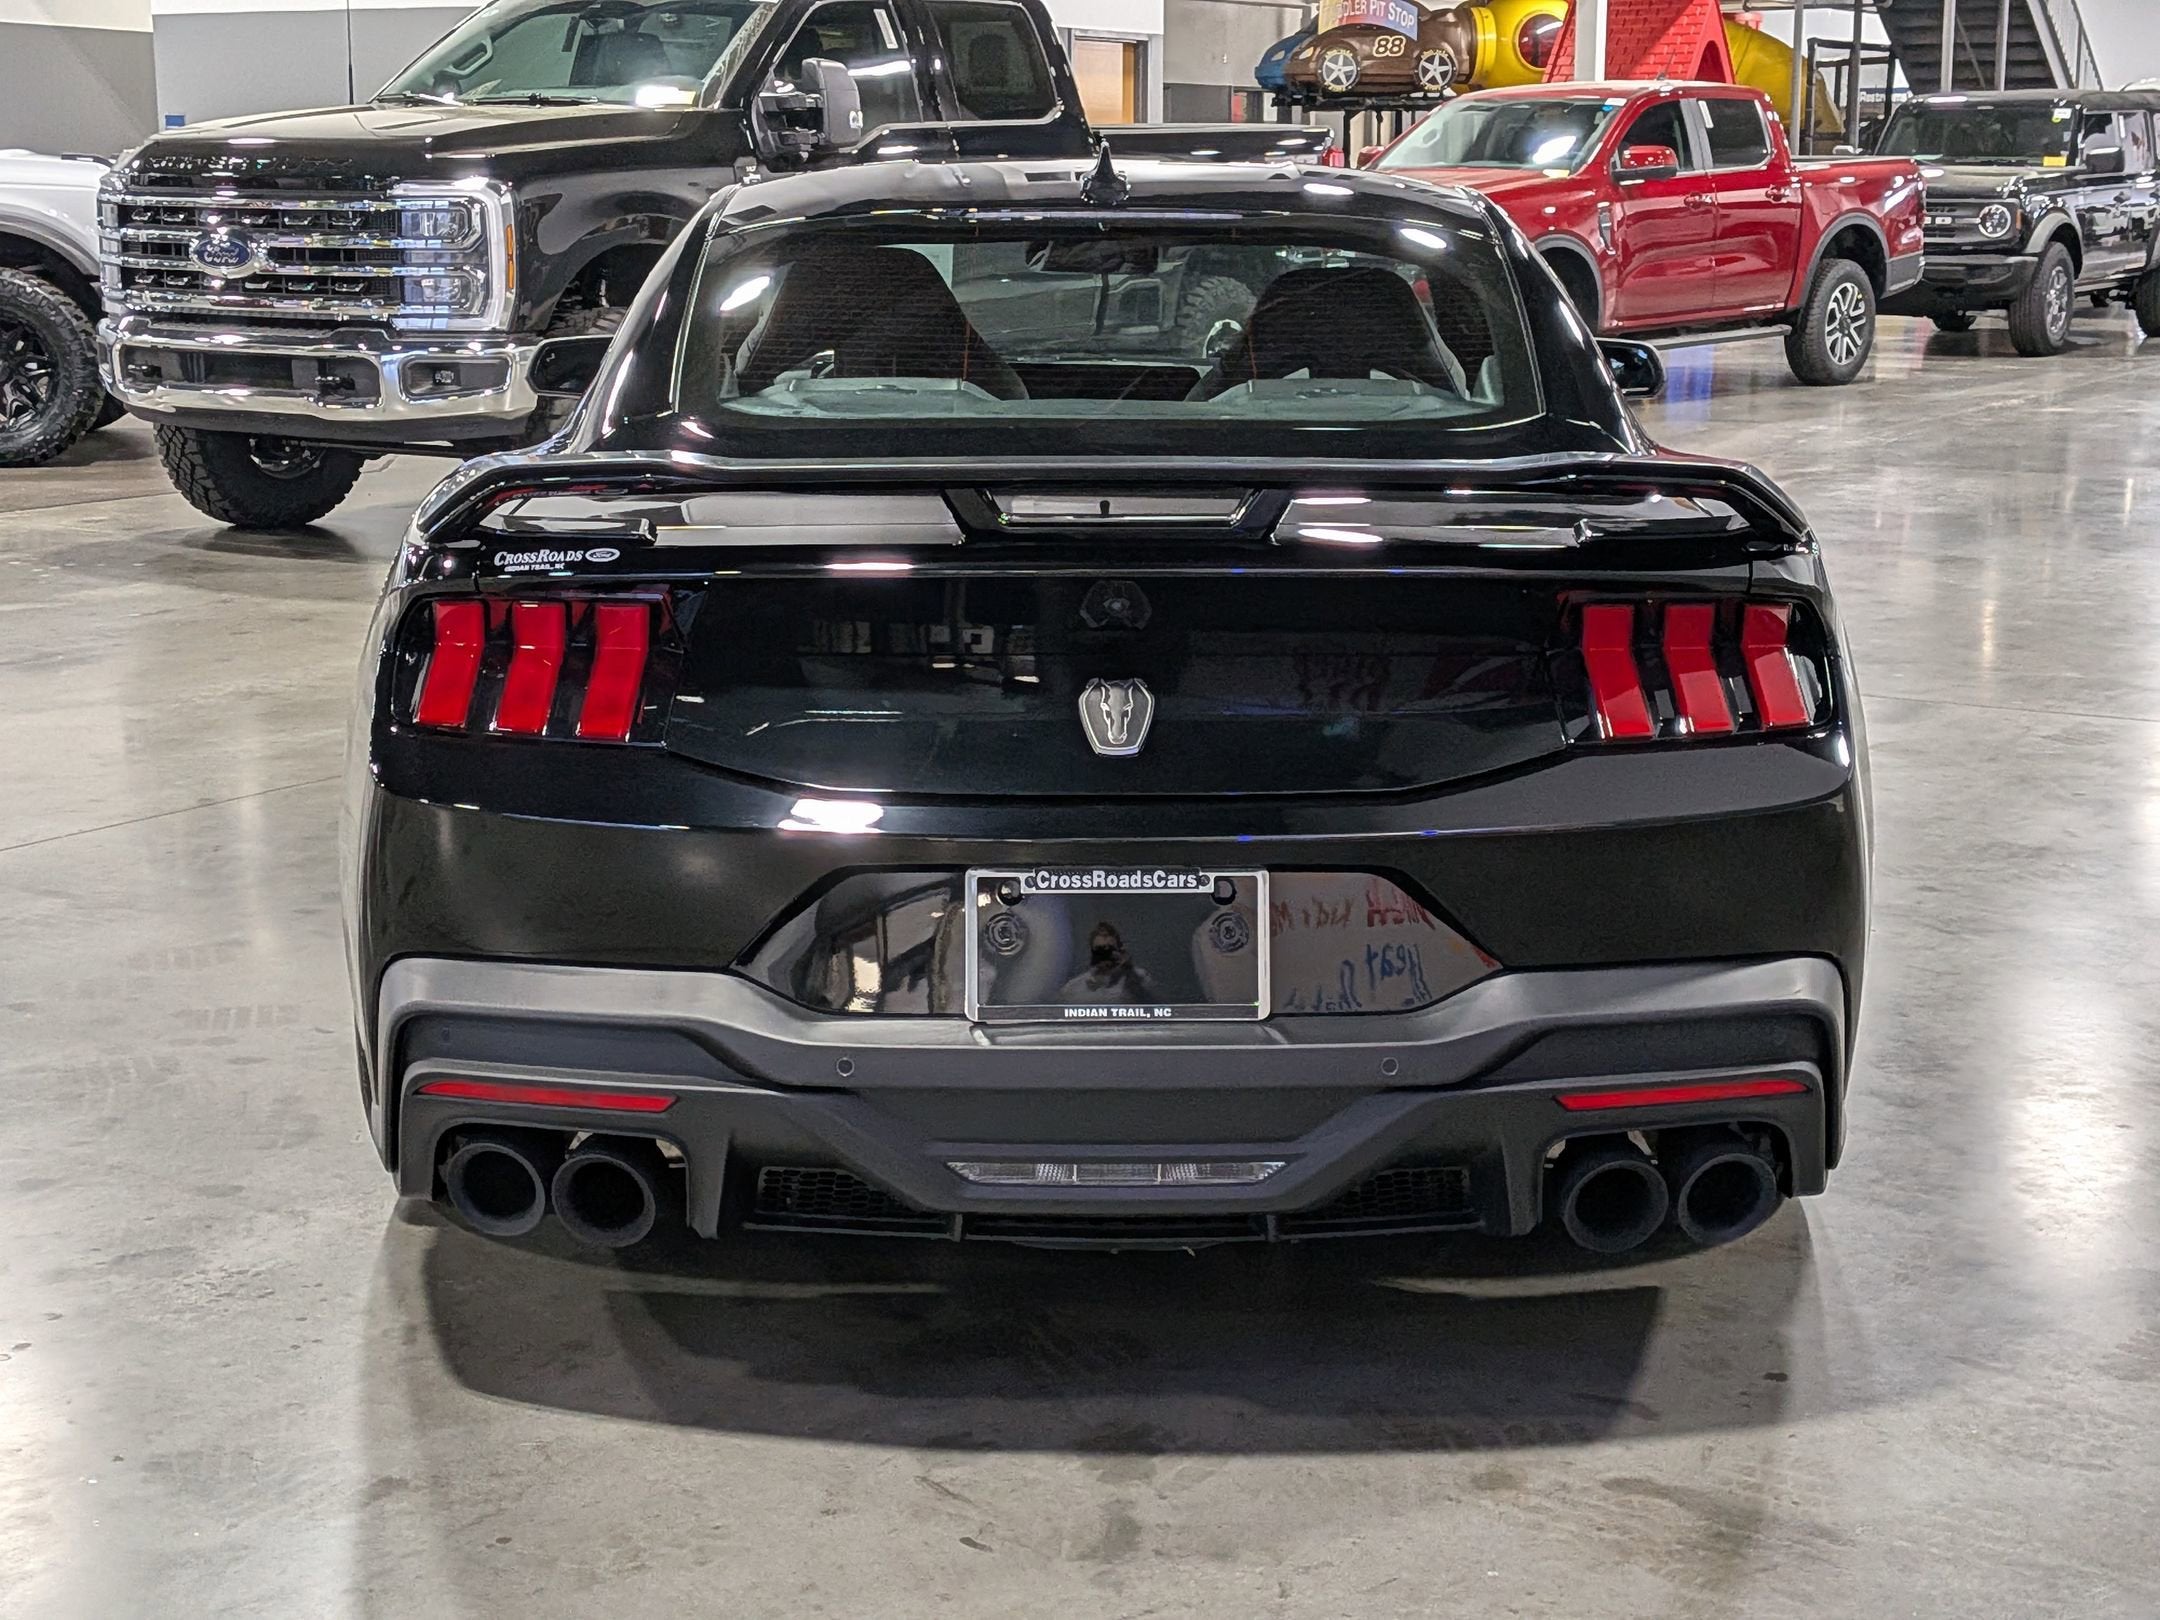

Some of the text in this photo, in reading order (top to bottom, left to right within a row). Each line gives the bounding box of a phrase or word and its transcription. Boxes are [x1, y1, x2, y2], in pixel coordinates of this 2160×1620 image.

[1369, 0, 1386, 17] PIT
[1388, 2, 1415, 28] STOP
[1374, 36, 1406, 57] 88
[1036, 870, 1198, 888] CrossRoadsCars
[1064, 1008, 1172, 1019] INDIAN TRAIL, NC
